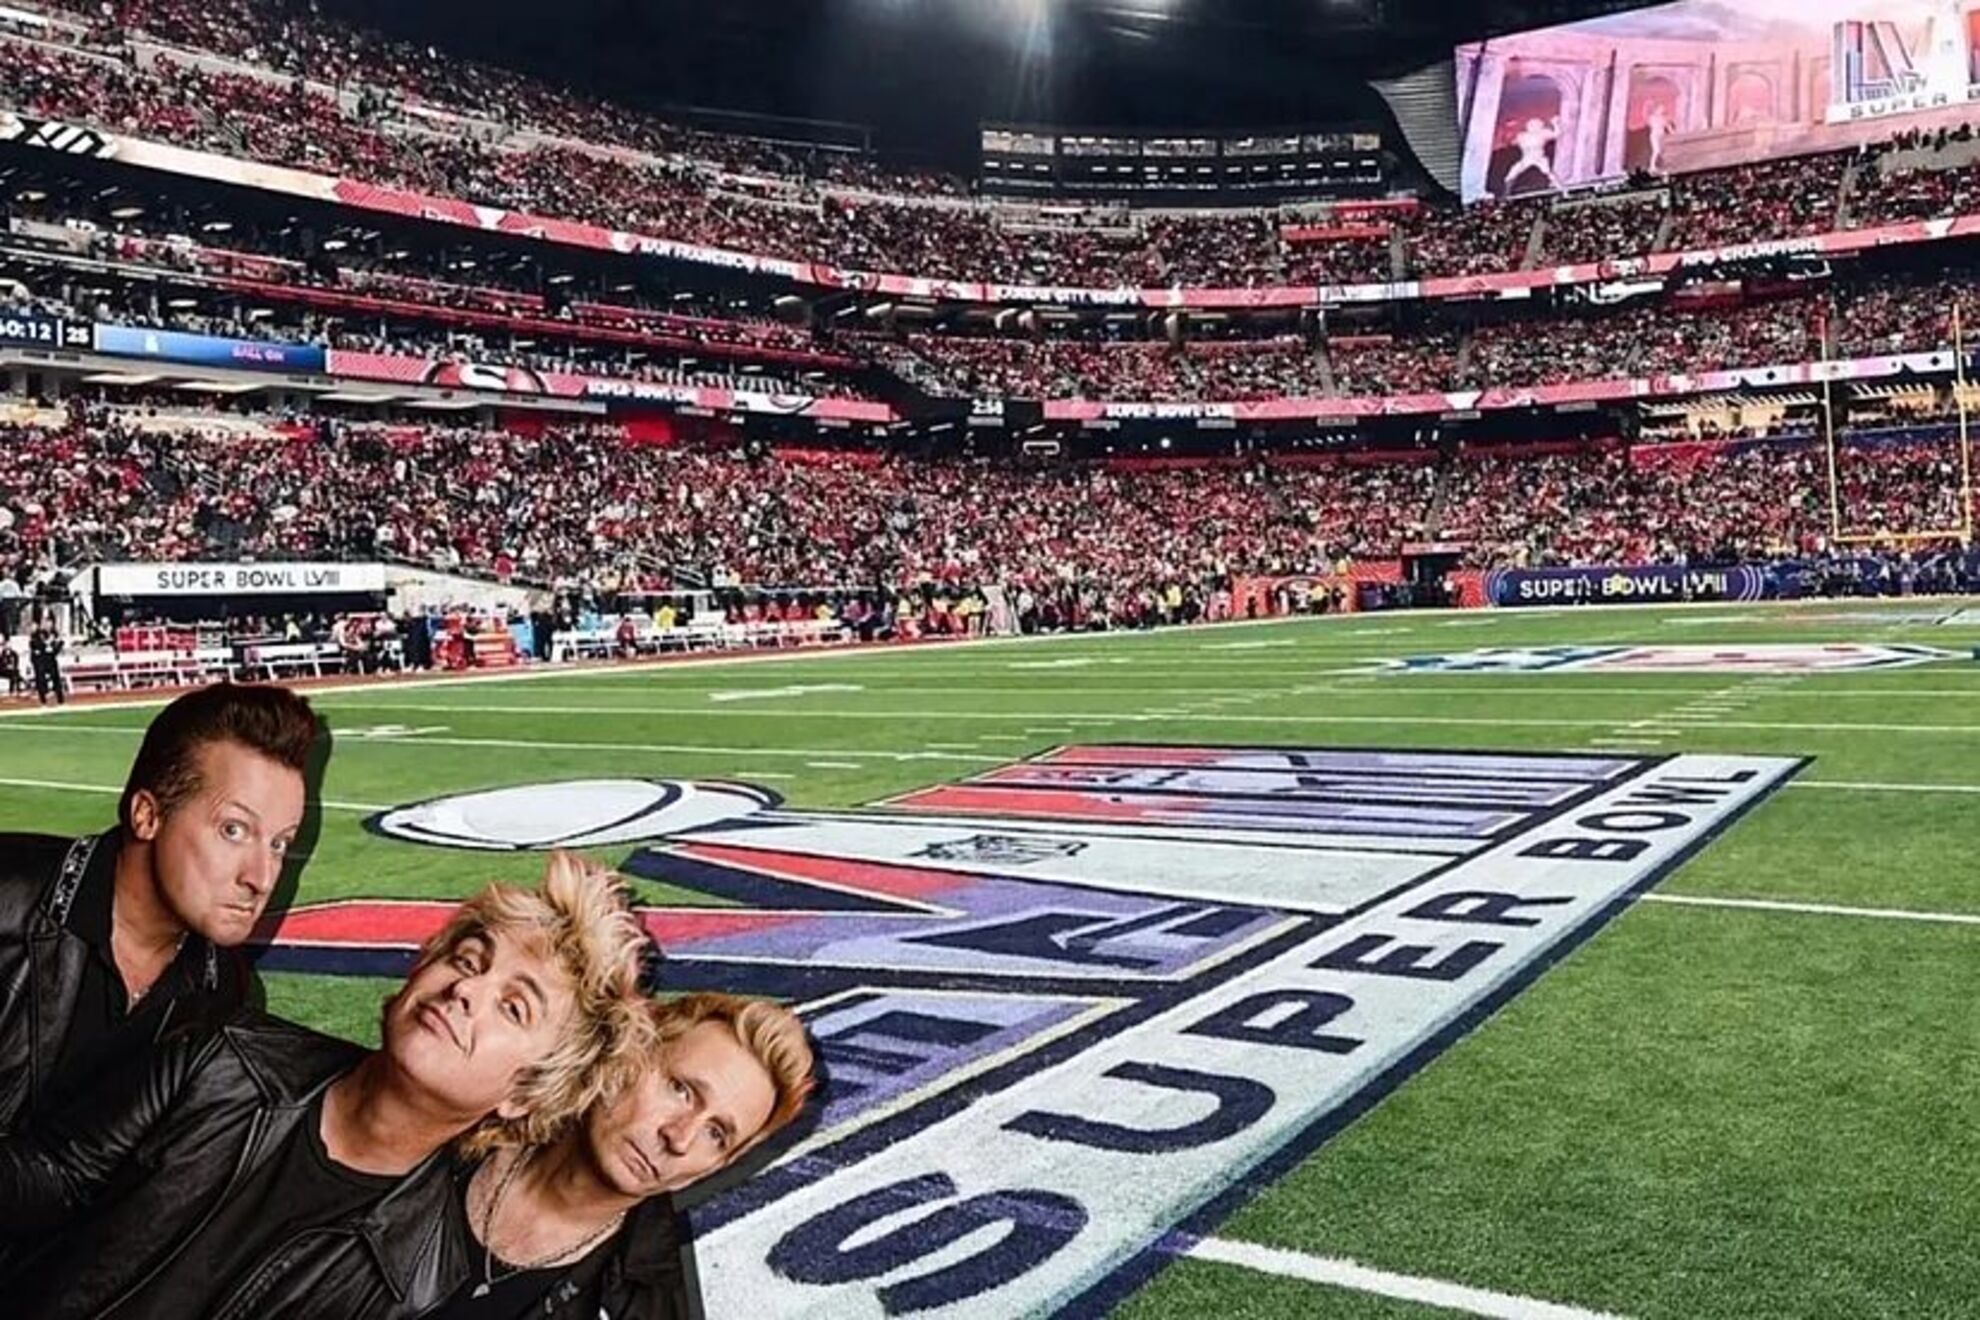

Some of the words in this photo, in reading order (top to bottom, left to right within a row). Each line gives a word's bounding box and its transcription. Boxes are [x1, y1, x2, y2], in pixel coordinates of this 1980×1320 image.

[1850, 93, 1948, 118] SUPER
[157, 570, 226, 589] SUPER
[236, 569, 296, 588] BOWL
[766, 890, 1576, 1316] SUPER
[1518, 769, 1760, 862] BOWL
